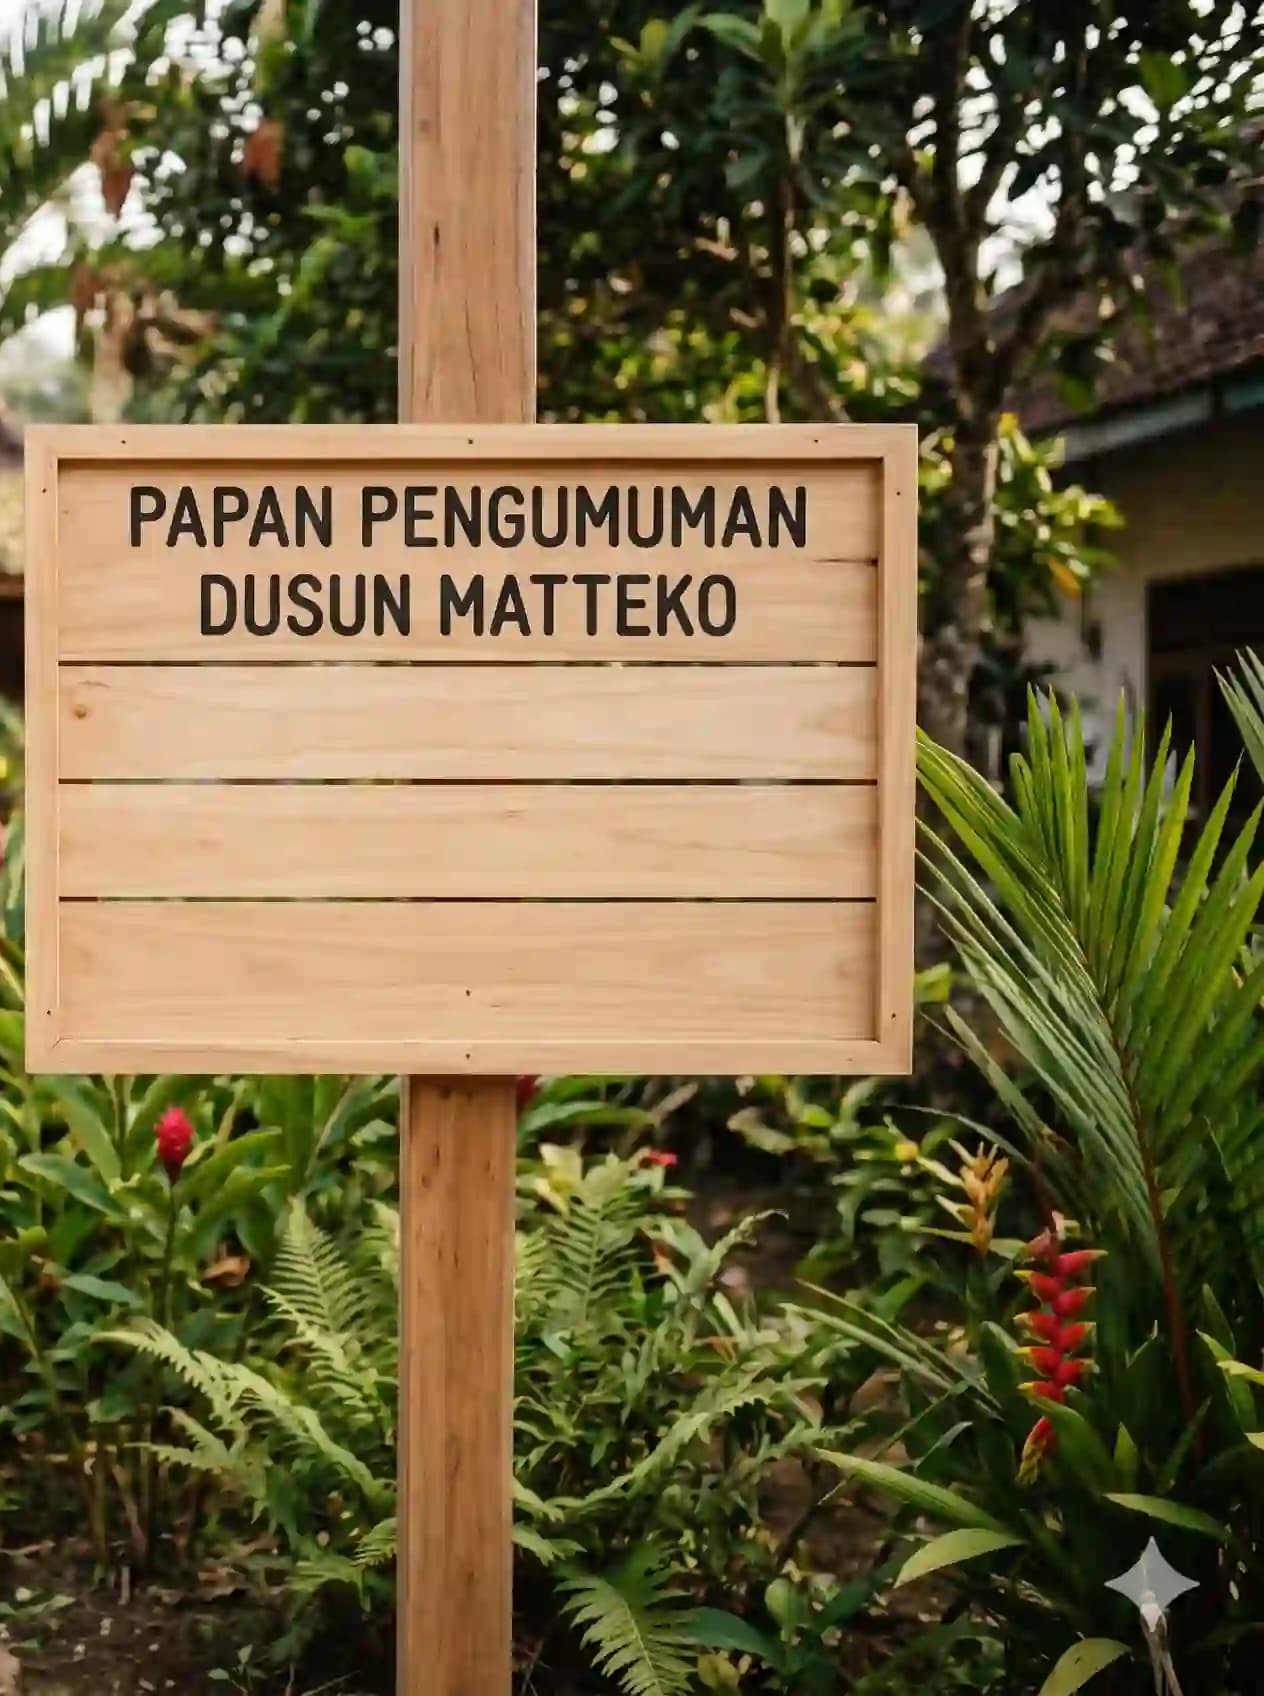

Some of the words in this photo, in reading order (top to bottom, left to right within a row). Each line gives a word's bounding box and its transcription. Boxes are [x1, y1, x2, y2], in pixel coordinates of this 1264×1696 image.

[131, 486, 331, 548] PAPAN
[362, 486, 806, 548] PENGUMUMAN
[201, 574, 410, 637] DUSUN
[440, 574, 736, 637] MATTEKO
